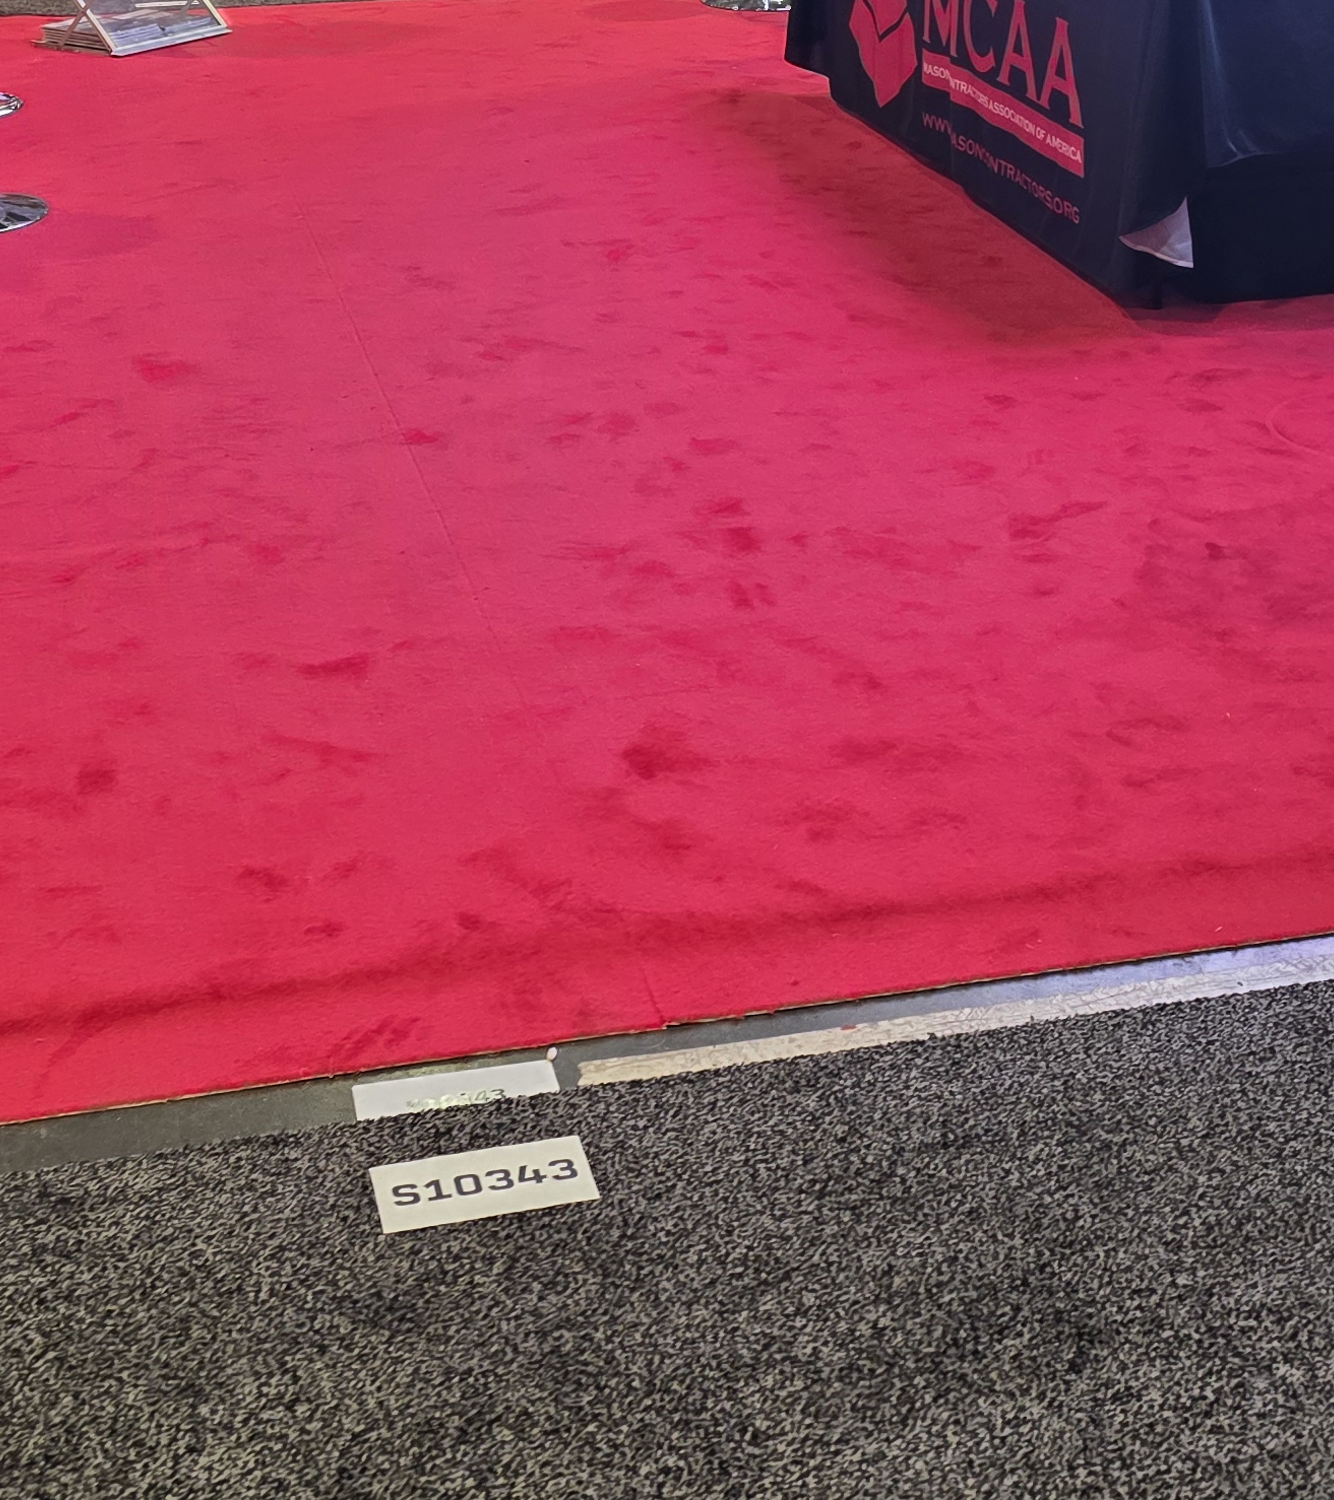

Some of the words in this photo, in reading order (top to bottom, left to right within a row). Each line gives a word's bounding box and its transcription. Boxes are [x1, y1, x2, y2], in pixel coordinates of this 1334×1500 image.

[988, 99, 1035, 137] ASSOCIATION
[1035, 127, 1047, 141] OF
[1046, 133, 1082, 164] AMERICA
[390, 1158, 579, 1207] S10343
